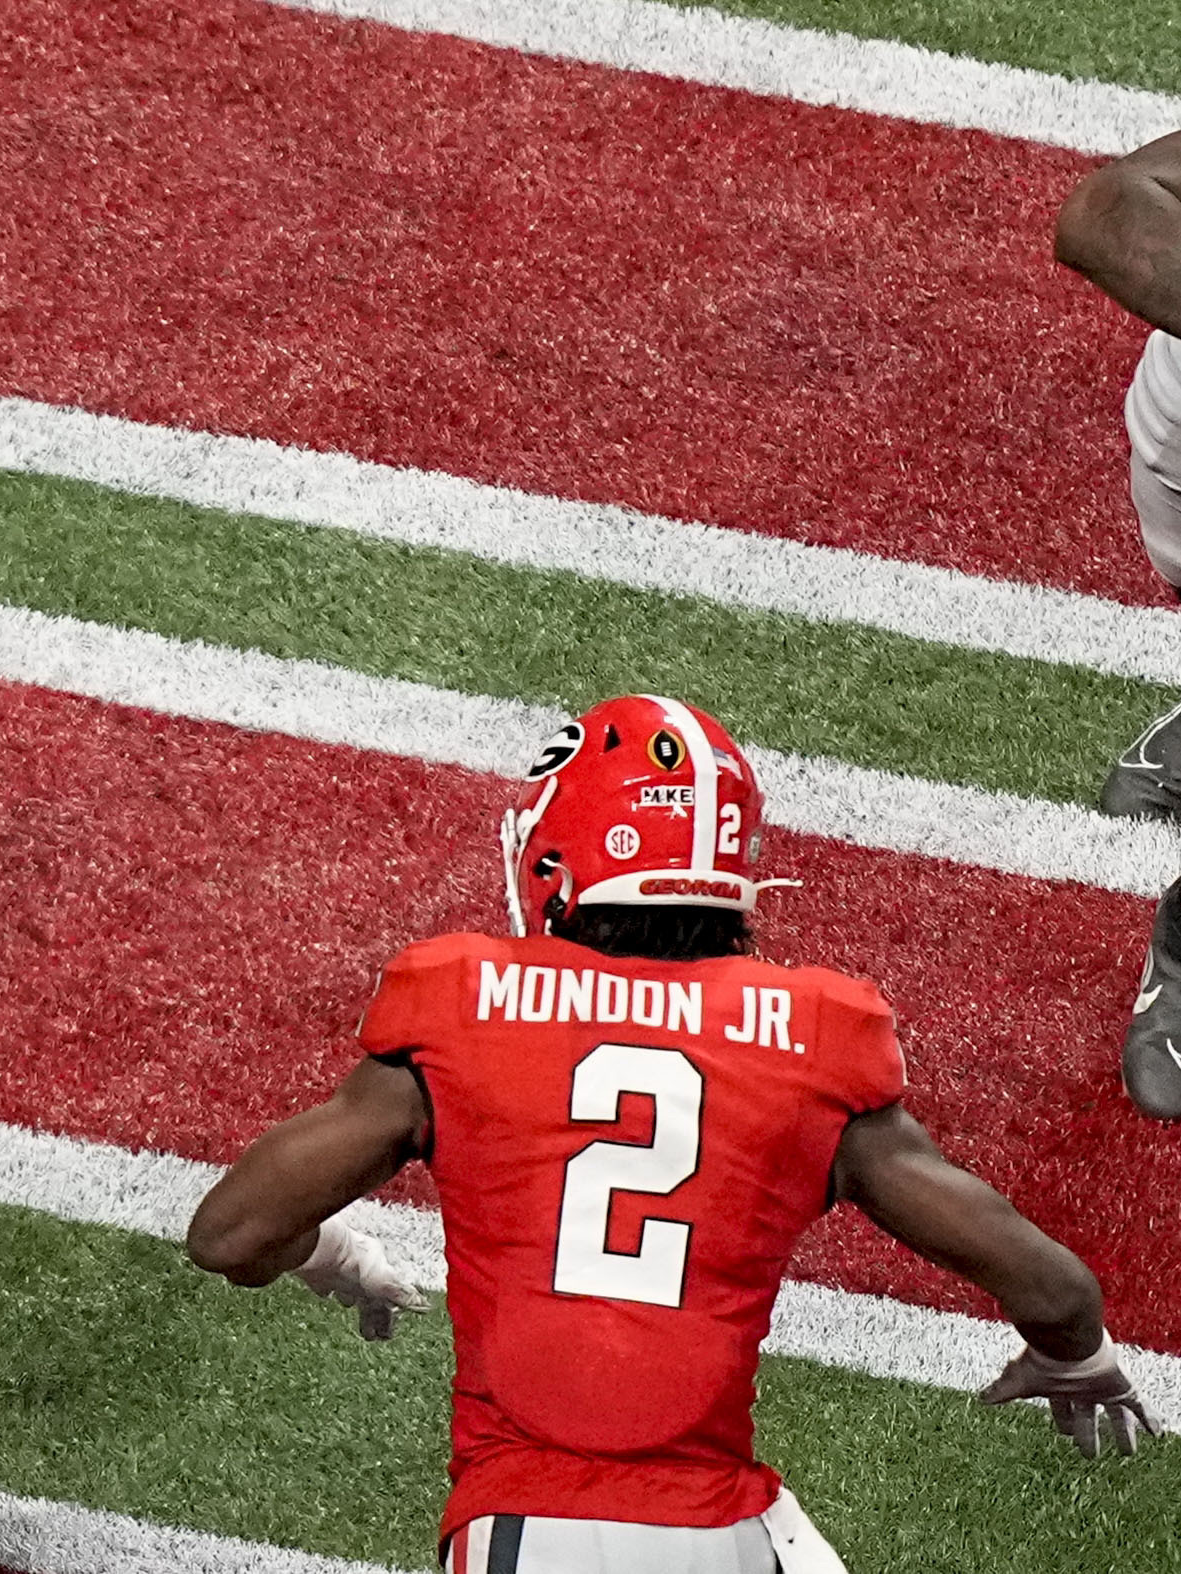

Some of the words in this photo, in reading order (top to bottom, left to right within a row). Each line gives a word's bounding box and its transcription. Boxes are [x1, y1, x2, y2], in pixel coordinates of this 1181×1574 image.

[610, 829, 635, 855] SEC
[717, 802, 742, 855] 2
[476, 960, 703, 1035] MONDON
[724, 986, 805, 1055] JR.
[552, 1042, 705, 1310] 2
